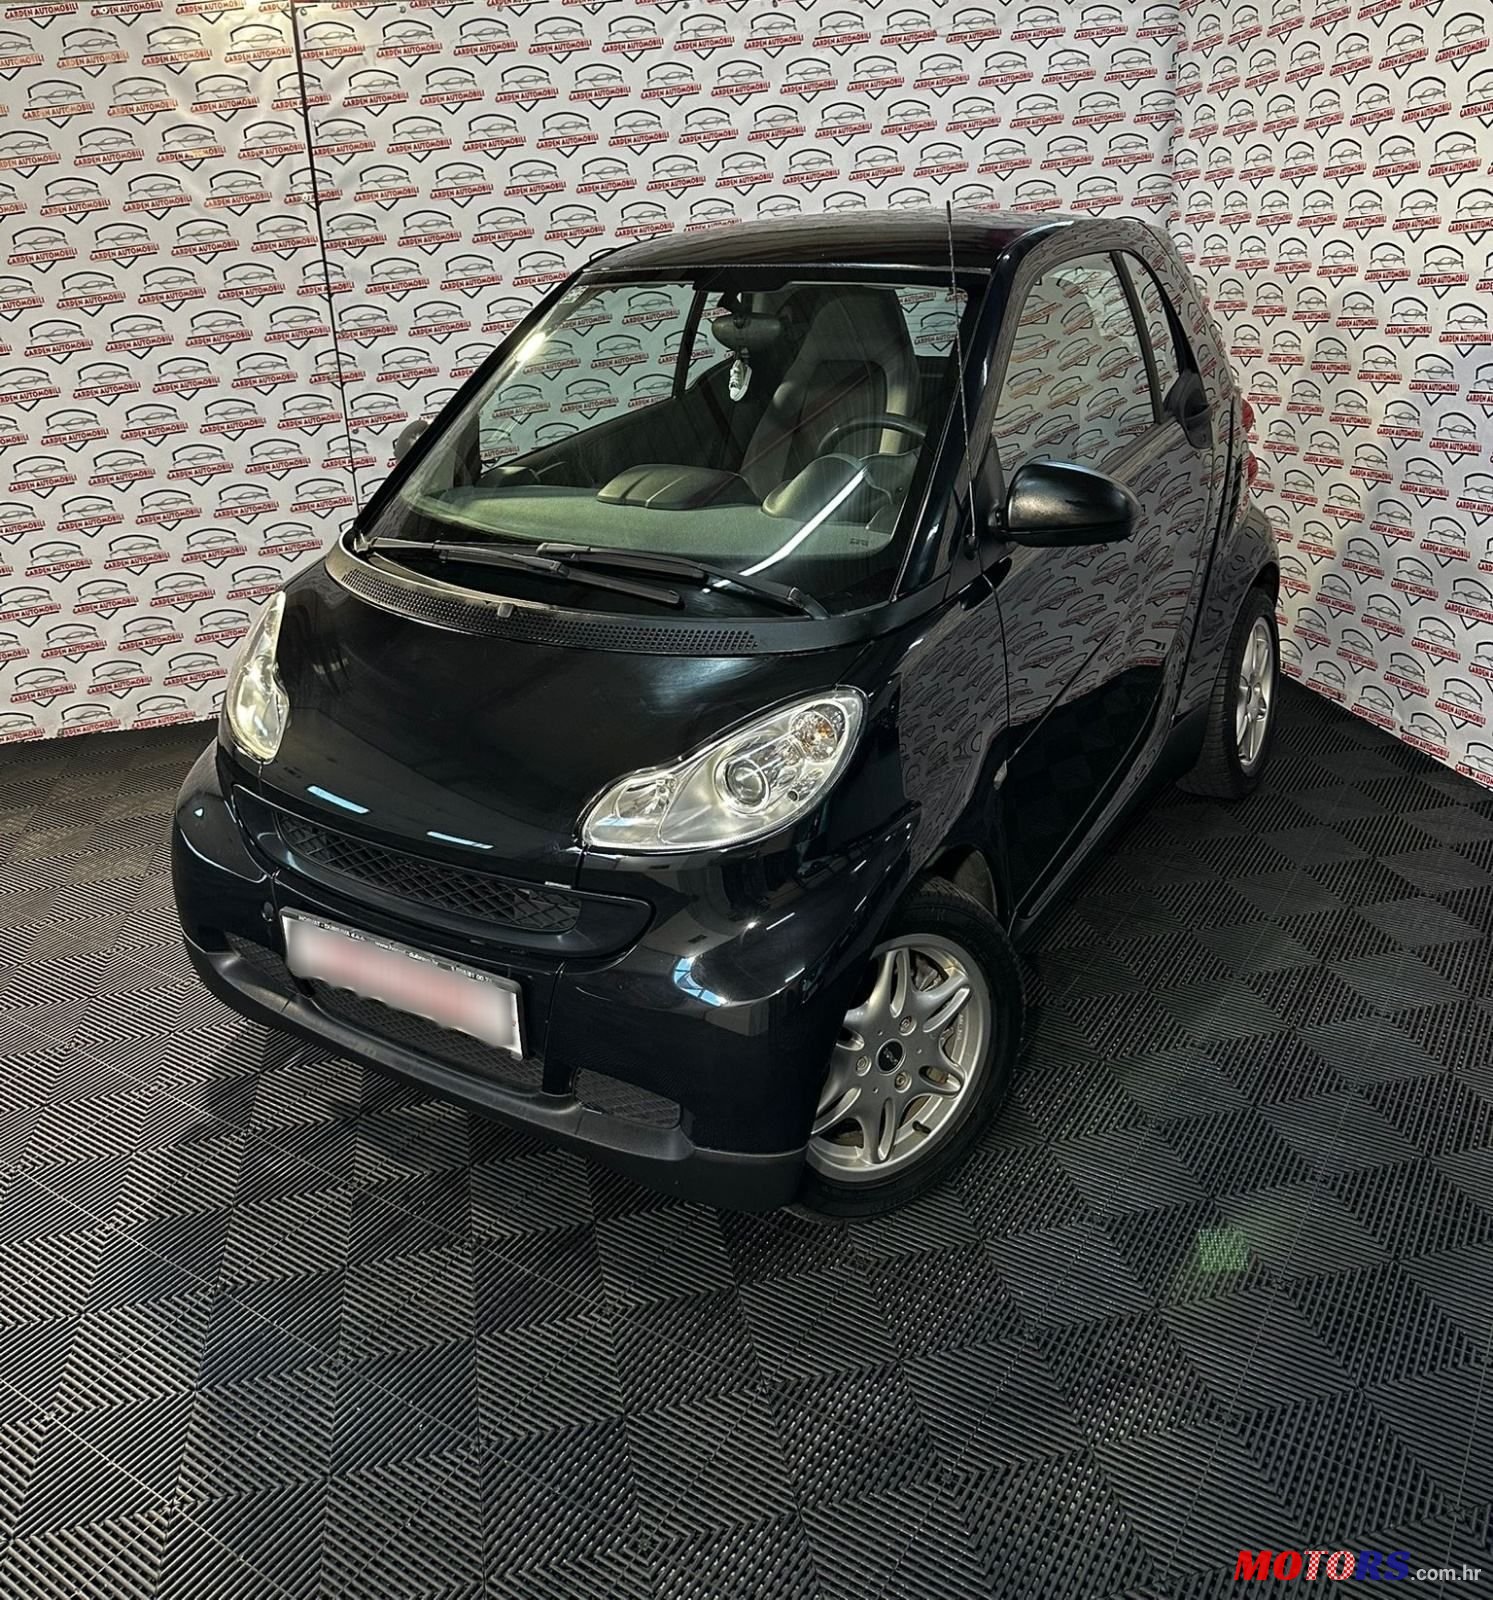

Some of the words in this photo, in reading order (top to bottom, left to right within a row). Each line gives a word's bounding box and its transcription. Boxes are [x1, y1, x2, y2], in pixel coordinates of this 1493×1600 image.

[34, 2, 78, 15] AUTOMOBILI
[836, 31, 871, 43] AUTOMOBILI
[968, 28, 1002, 40] AUTOMOBILI
[1095, 25, 1128, 36] AUTOMOBILI
[554, 39, 592, 51] AUTOMOBILI
[698, 35, 735, 47] AUTOMOBILI
[1456, 37, 1490, 56] AUTOMOBILI
[403, 42, 443, 54] AUTOMOBILI
[86, 51, 129, 64] AUTOMOBILI
[803, 78, 838, 90] AUTOMOBILI
[935, 74, 970, 85] AUTOMOBILI
[521, 87, 559, 99] AUTOMOBILI
[665, 83, 702, 95] AUTOMOBILI
[218, 96, 260, 109] AUTOMOBILI
[369, 91, 409, 103] AUTOMOBILI
[51, 102, 95, 115] AUTOMOBILI
[1420, 101, 1451, 118] AUTOMOBILI
[1093, 111, 1126, 122] AUTOMOBILI
[903, 119, 937, 131] AUTOMOBILI
[561, 133, 599, 145] AUTOMOBILI
[702, 128, 739, 140] AUTOMOBILI
[413, 138, 452, 150] AUTOMOBILI
[102, 149, 145, 162] AUTOMOBILI
[999, 157, 1032, 169] AUTOMOBILI
[1448, 157, 1481, 172] AUTOMOBILI
[805, 168, 840, 180] AUTOMOBILI
[529, 181, 566, 193] AUTOMOBILI
[670, 175, 706, 187] AUTOMOBILI
[232, 191, 272, 204] AUTOMOBILI
[380, 186, 419, 198] AUTOMOBILI
[68, 198, 111, 211] AUTOMOBILI
[1091, 194, 1123, 206] AUTOMOBILI
[1411, 215, 1441, 228] AUTOMOBILI
[423, 230, 462, 243] AUTOMOBILI
[569, 224, 605, 236] AUTOMOBILI
[198, 239, 239, 252] AUTOMOBILI
[35, 247, 78, 261] AUTOMOBILI
[391, 277, 429, 290] AUTOMOBILI
[1437, 273, 1469, 284] AUTOMOBILI
[245, 283, 285, 295] AUTOMOBILI
[84, 291, 126, 304] AUTOMOBILI
[212, 329, 253, 342] AUTOMOBILI
[1403, 325, 1432, 334] AUTOMOBILI
[52, 339, 93, 352] AUTOMOBILI
[402, 366, 439, 378] AUTOMOBILI
[100, 381, 141, 394] AUTOMOBILI
[1428, 383, 1459, 391] AUTOMOBILI
[226, 417, 266, 430] AUTOMOBILI
[68, 427, 109, 441] AUTOMOBILI
[1449, 442, 1481, 452] AUTOMOBILI
[194, 462, 234, 475] AUTOMOBILI
[36, 474, 77, 487] AUTOMOBILI
[316, 495, 354, 508] AUTOMOBILI
[1339, 509, 1365, 520] AUTOMOBILI
[208, 545, 247, 558] AUTOMOBILI
[1439, 545, 1470, 559] AUTOMOBILI
[52, 558, 92, 571] AUTOMOBILI
[144, 632, 184, 645] AUTOMOBILI
[1430, 644, 1461, 660] AUTOMOBILI
[37, 683, 77, 697] AUTOMOBILI
[1454, 706, 1486, 725] AUTOMOBILI
